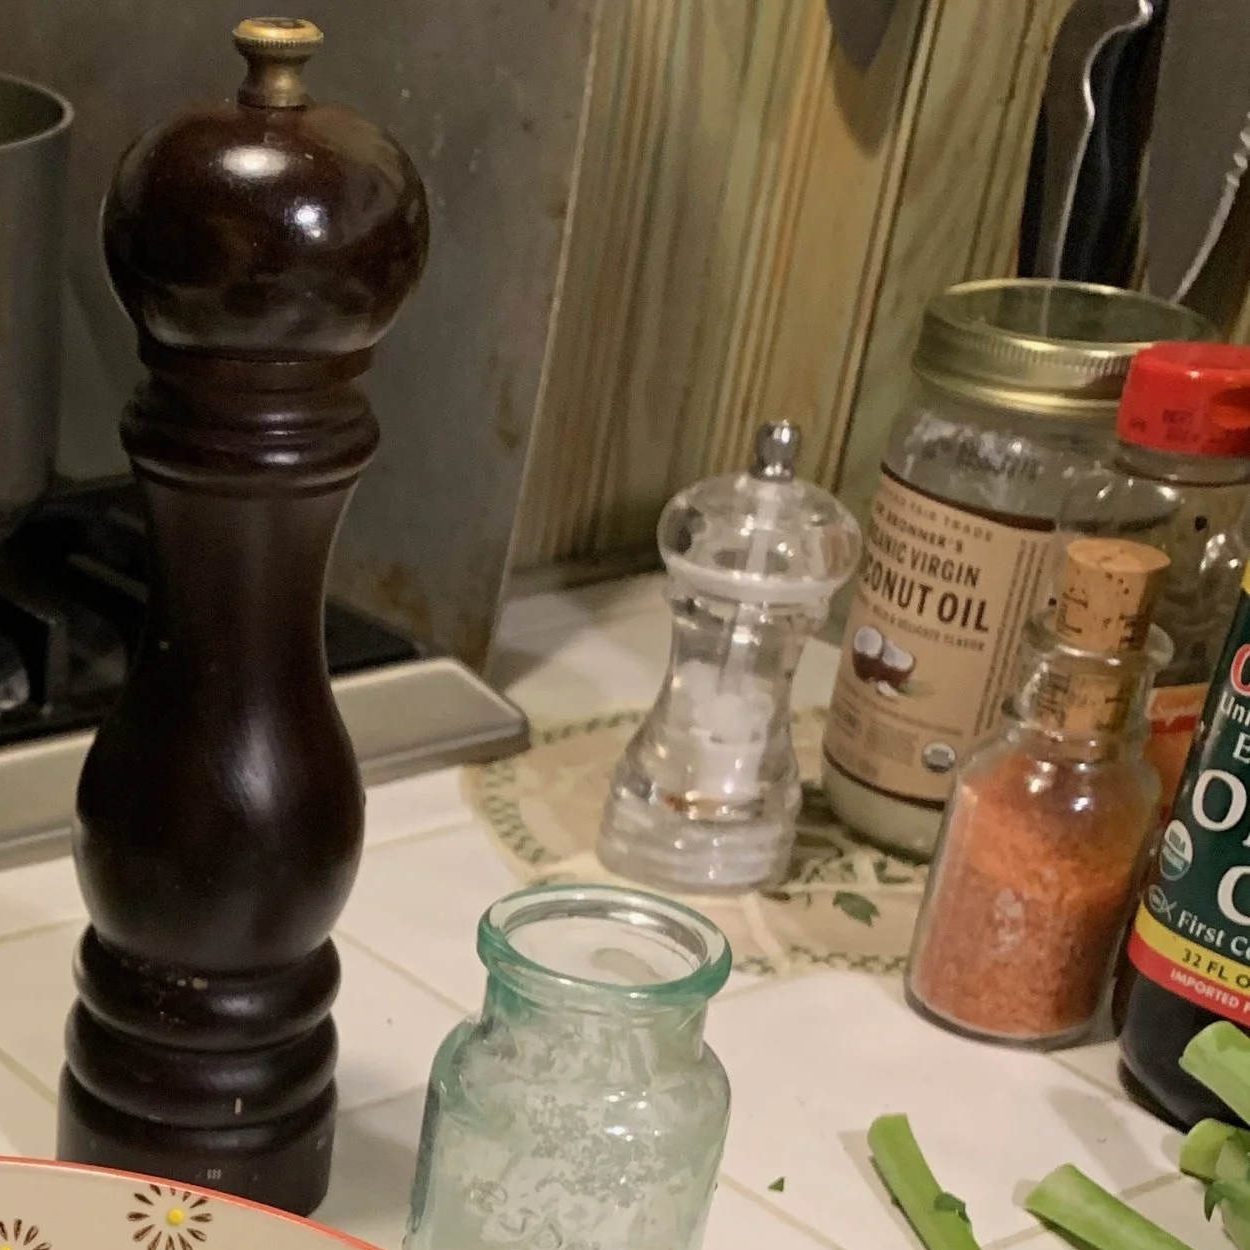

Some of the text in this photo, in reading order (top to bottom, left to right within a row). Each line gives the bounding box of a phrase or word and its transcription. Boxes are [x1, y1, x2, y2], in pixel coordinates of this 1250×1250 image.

[910, 546, 982, 589] VIRGIN
[937, 590, 991, 634] OIL
[1176, 908, 1227, 949] First
[1181, 947, 1202, 970] 32
[1206, 959, 1229, 982] FL
[1169, 967, 1241, 1010] IMPORTED
